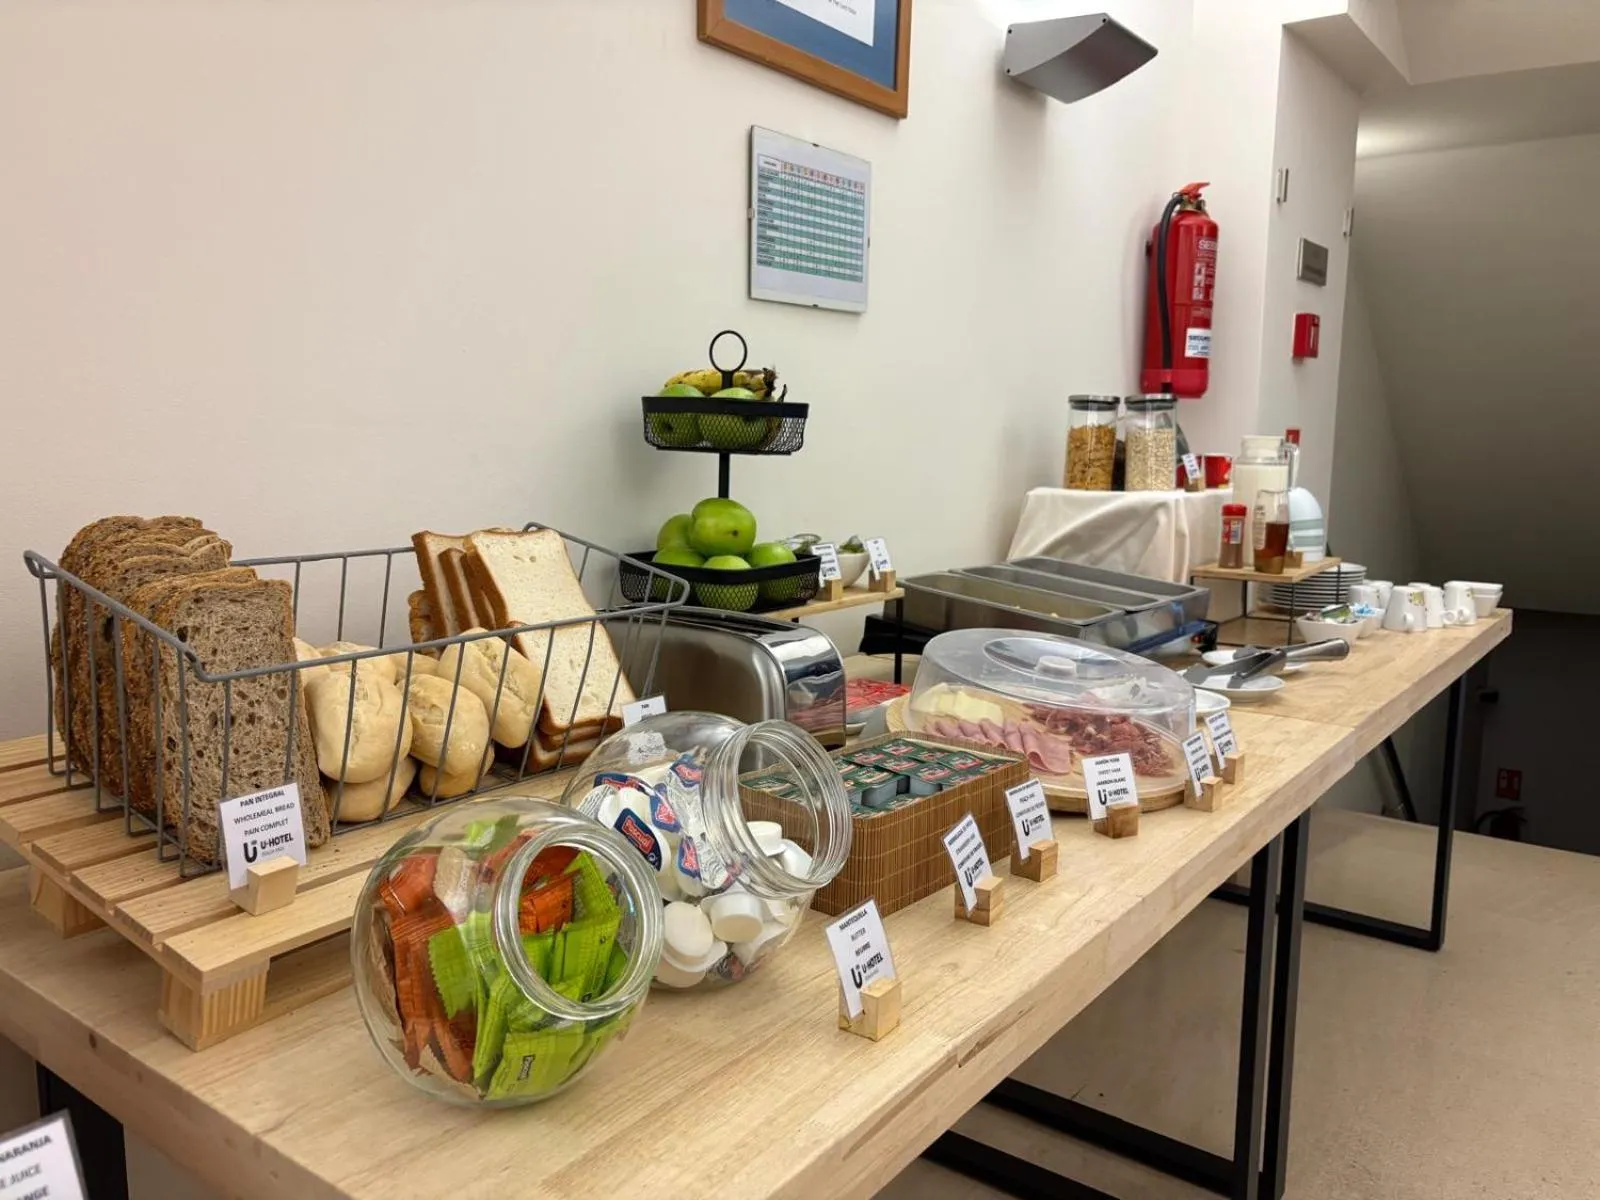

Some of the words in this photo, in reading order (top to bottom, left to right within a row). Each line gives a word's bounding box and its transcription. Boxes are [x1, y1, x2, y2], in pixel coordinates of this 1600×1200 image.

[240, 797, 254, 807] PAN
[255, 790, 285, 804] INTEGRAL
[234, 808, 273, 824] WHOLEMEAL
[275, 802, 295, 812] BREAD
[244, 825, 259, 836] PAIN
[260, 818, 289, 832] COMPLET
[260, 833, 293, 849] U-HOTEL
[862, 951, 883, 973] U-HOTEL
[10, 1163, 41, 1185] JUICE
